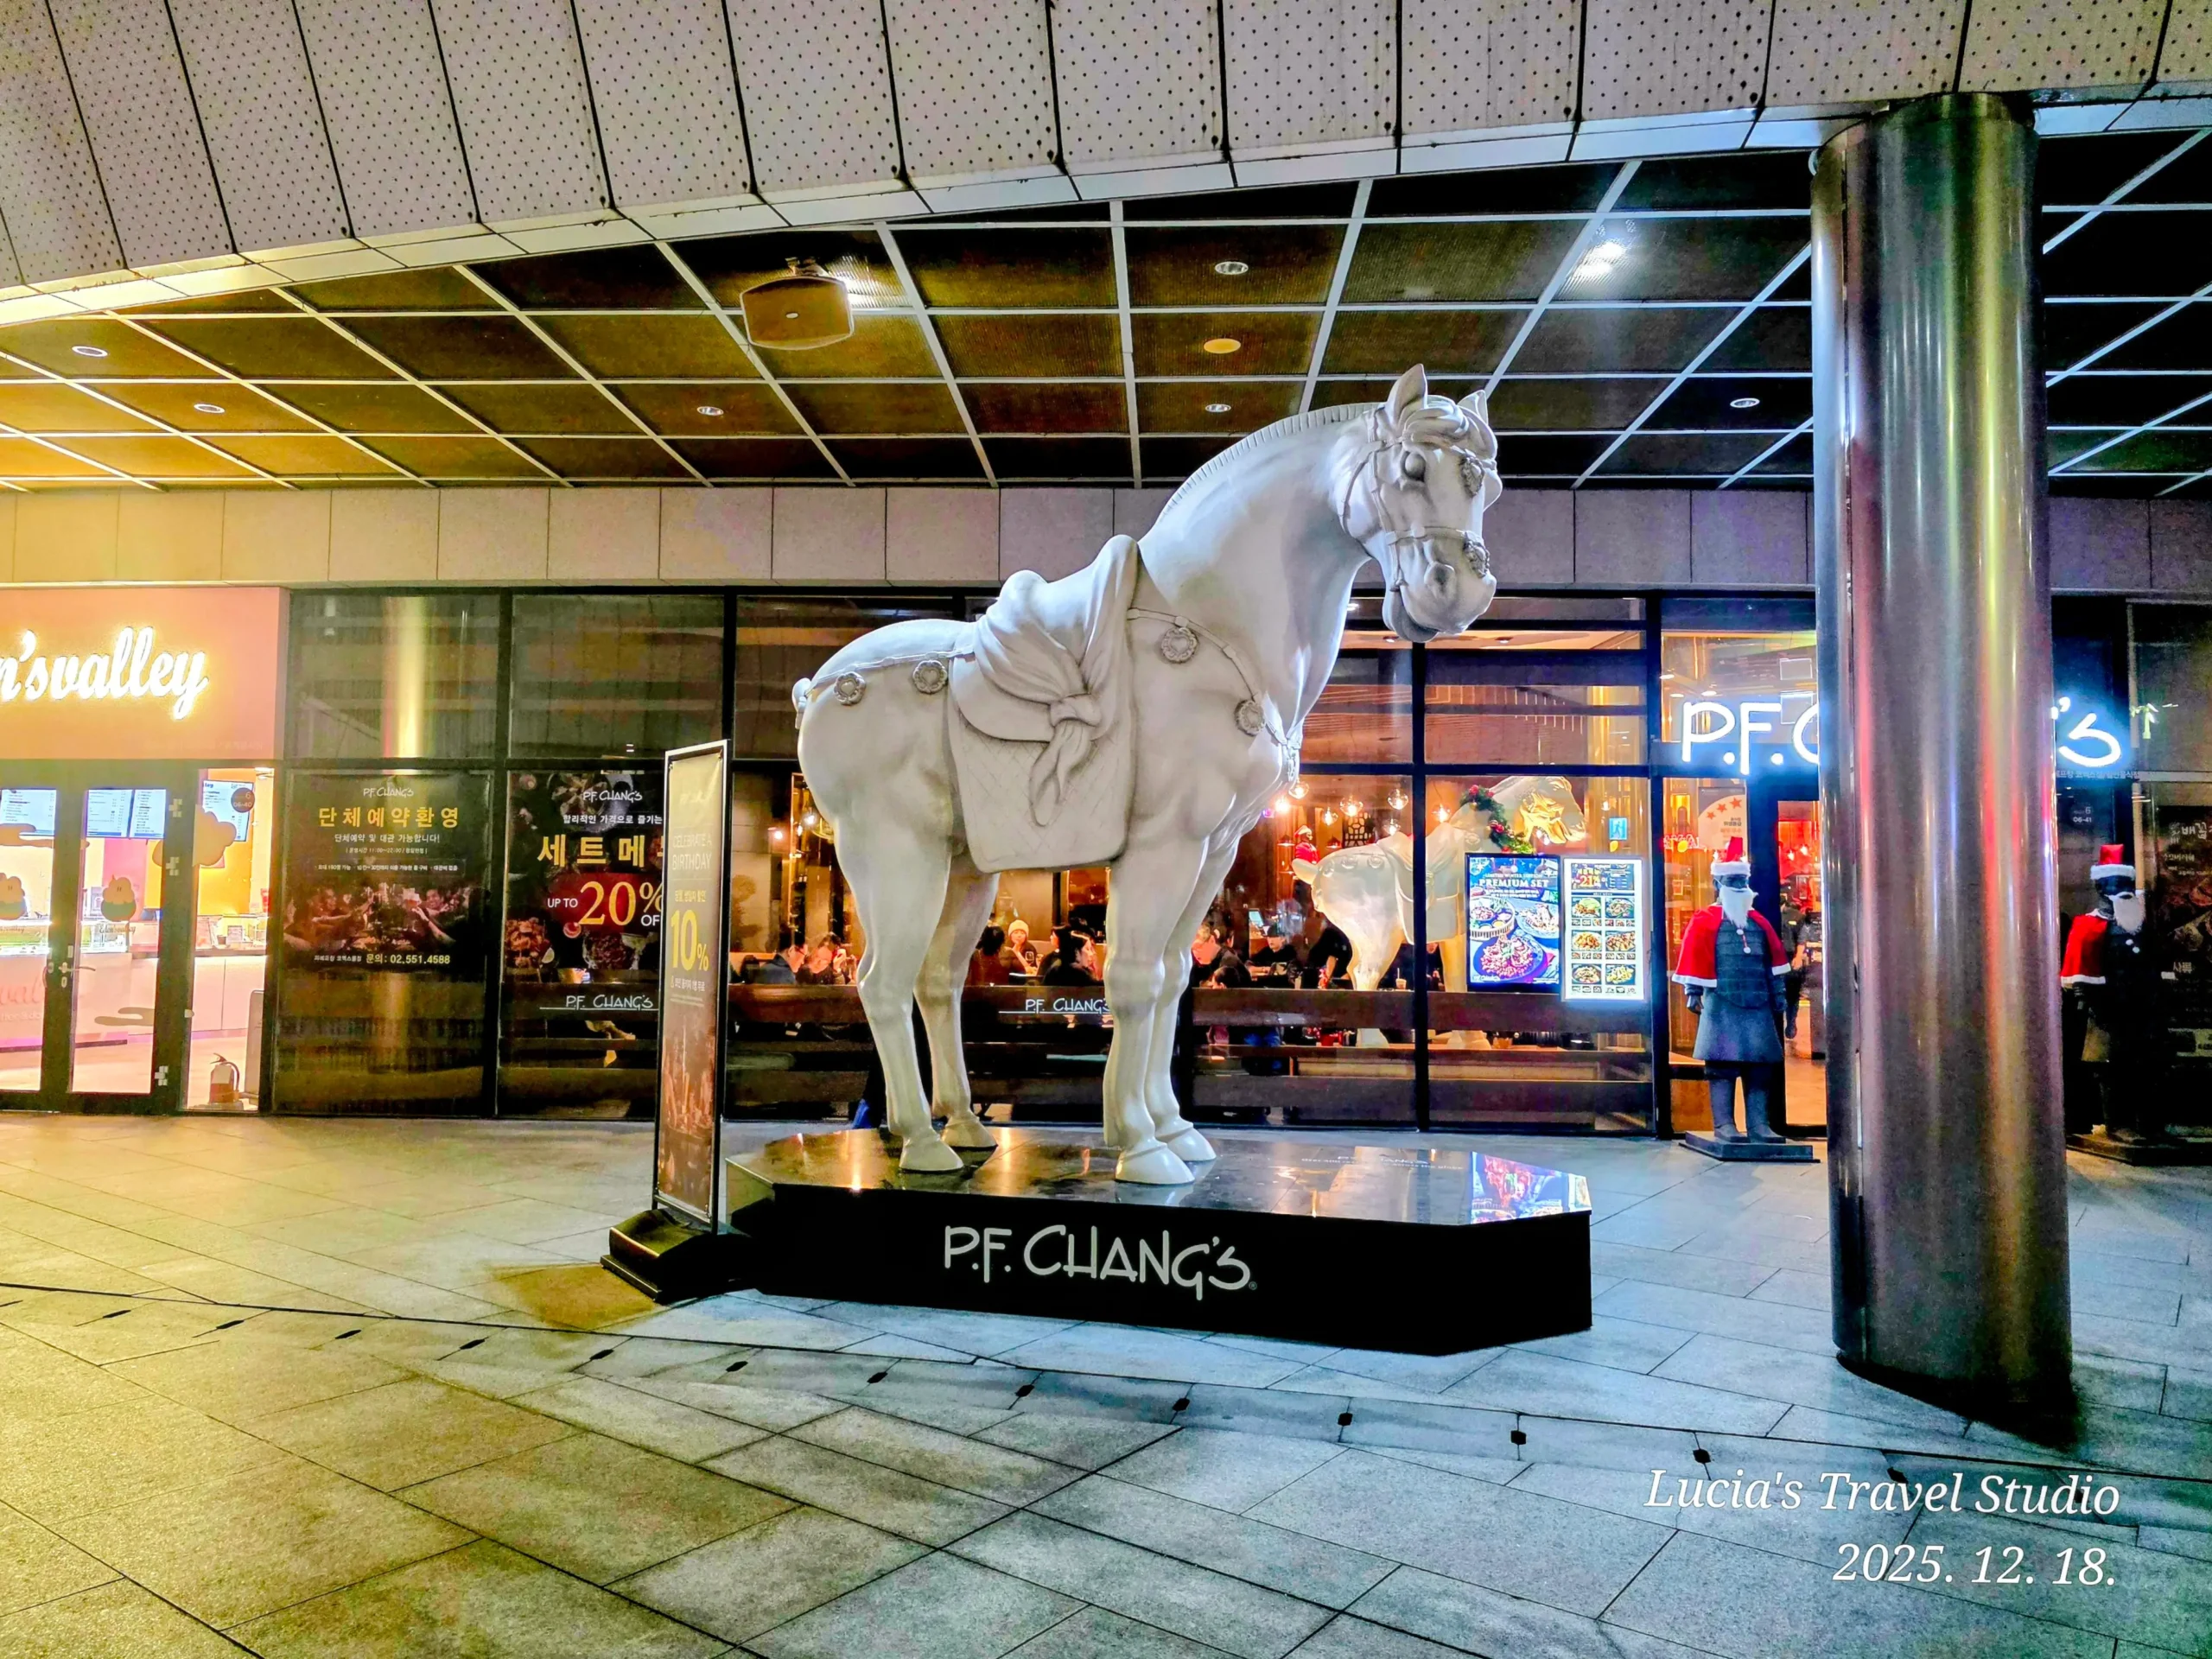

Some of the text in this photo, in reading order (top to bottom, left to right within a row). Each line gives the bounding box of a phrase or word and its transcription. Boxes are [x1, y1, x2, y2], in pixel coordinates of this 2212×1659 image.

[1681, 701, 1783, 775] P.F.
[363, 786, 415, 798] P.F. CHANG'S
[582, 790, 643, 803] P.F. CHANG'S
[563, 815, 663, 824] 합리적인 가격으로 즐기는
[334, 834, 440, 842] 단체예약 및 대관 가능합니다!
[672, 834, 706, 849] CELEBRATE
[672, 853, 712, 870] BIRTHDAY
[1478, 879, 1549, 888] PREMIUM SET
[547, 880, 663, 926] UP TO 20% OF
[671, 909, 709, 971] 10%
[365, 953, 387, 964] 문의:
[390, 954, 451, 964] 02.551.4588
[565, 995, 586, 1010] P.F.
[593, 994, 653, 1011] CHANG'S
[1025, 998, 1046, 1014] P.F.
[944, 1224, 1251, 1300] P.F. CHANG'S
